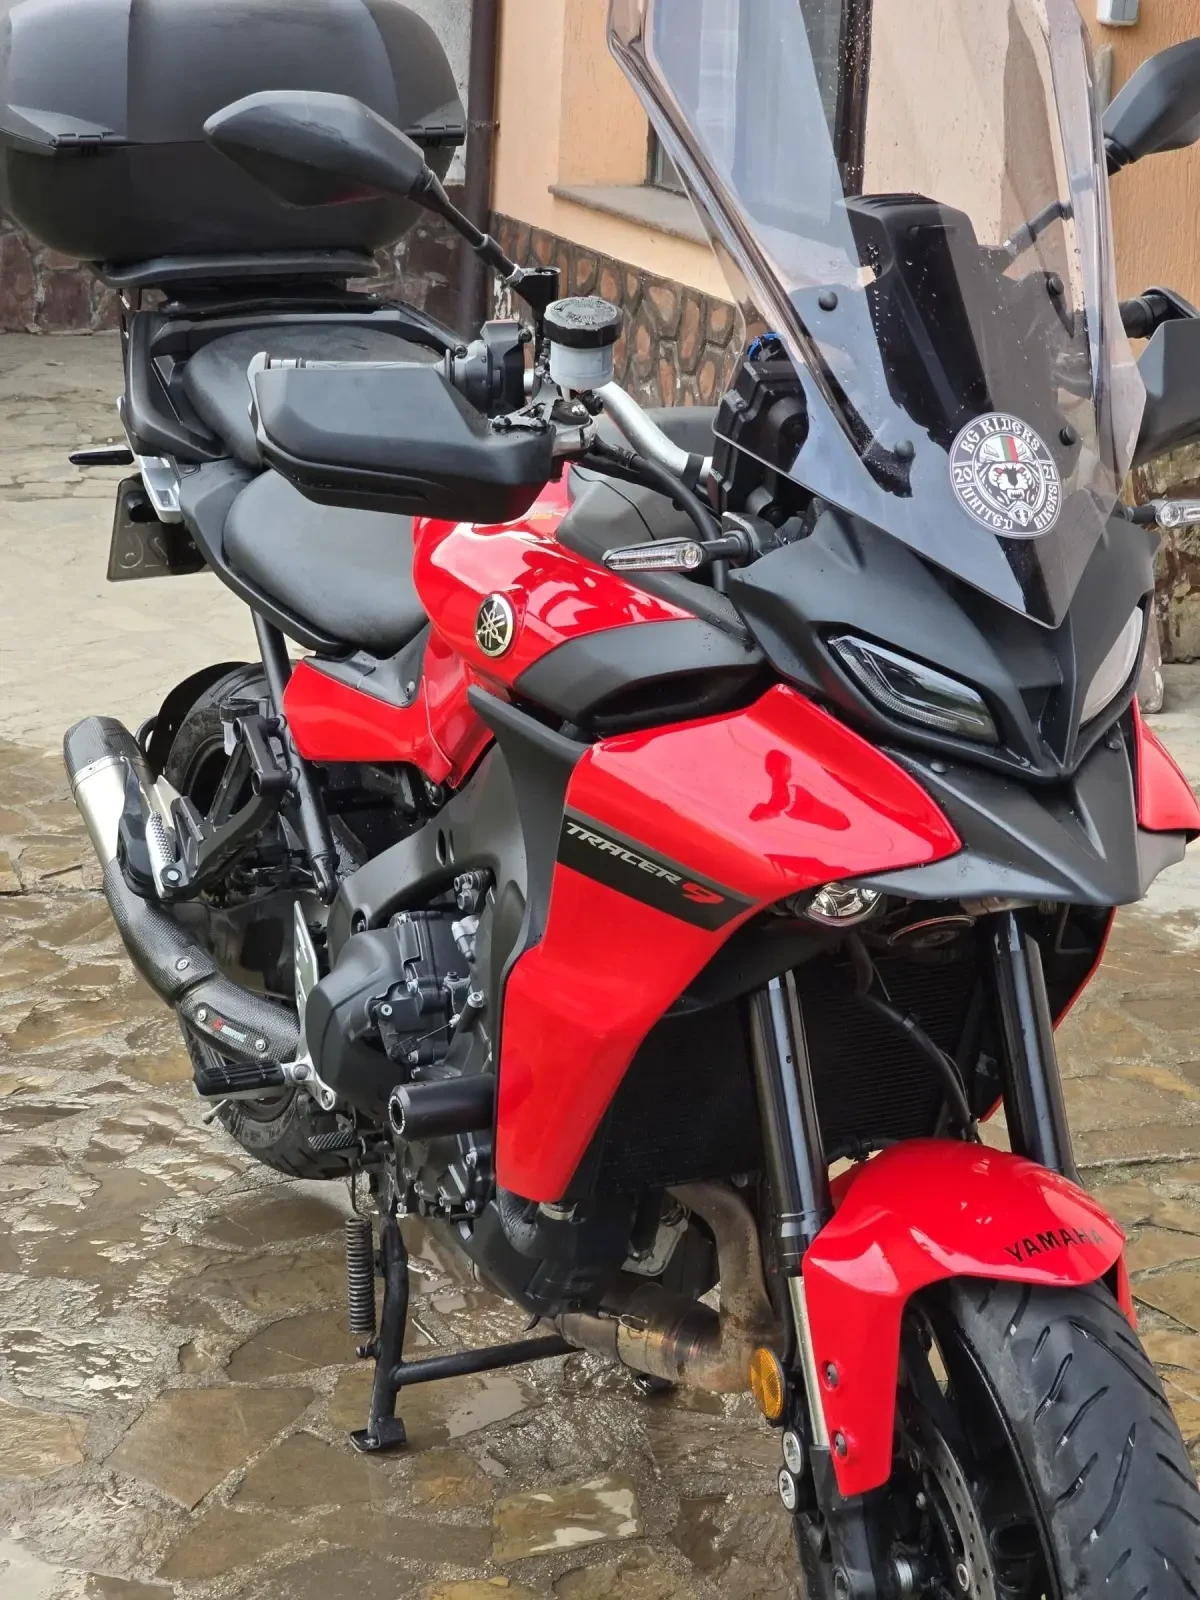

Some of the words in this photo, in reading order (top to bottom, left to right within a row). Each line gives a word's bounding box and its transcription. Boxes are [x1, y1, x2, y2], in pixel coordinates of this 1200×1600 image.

[960, 429, 980, 455] BG
[979, 417, 1041, 451] RIDERS
[954, 466, 973, 483] 20
[1043, 465, 1056, 480] 21
[961, 485, 1013, 530] UNITED
[1033, 484, 1058, 529] BIKERS
[566, 821, 682, 885] TRACER
[681, 880, 725, 905] 9
[1003, 1227, 1106, 1263] YAMAHA
